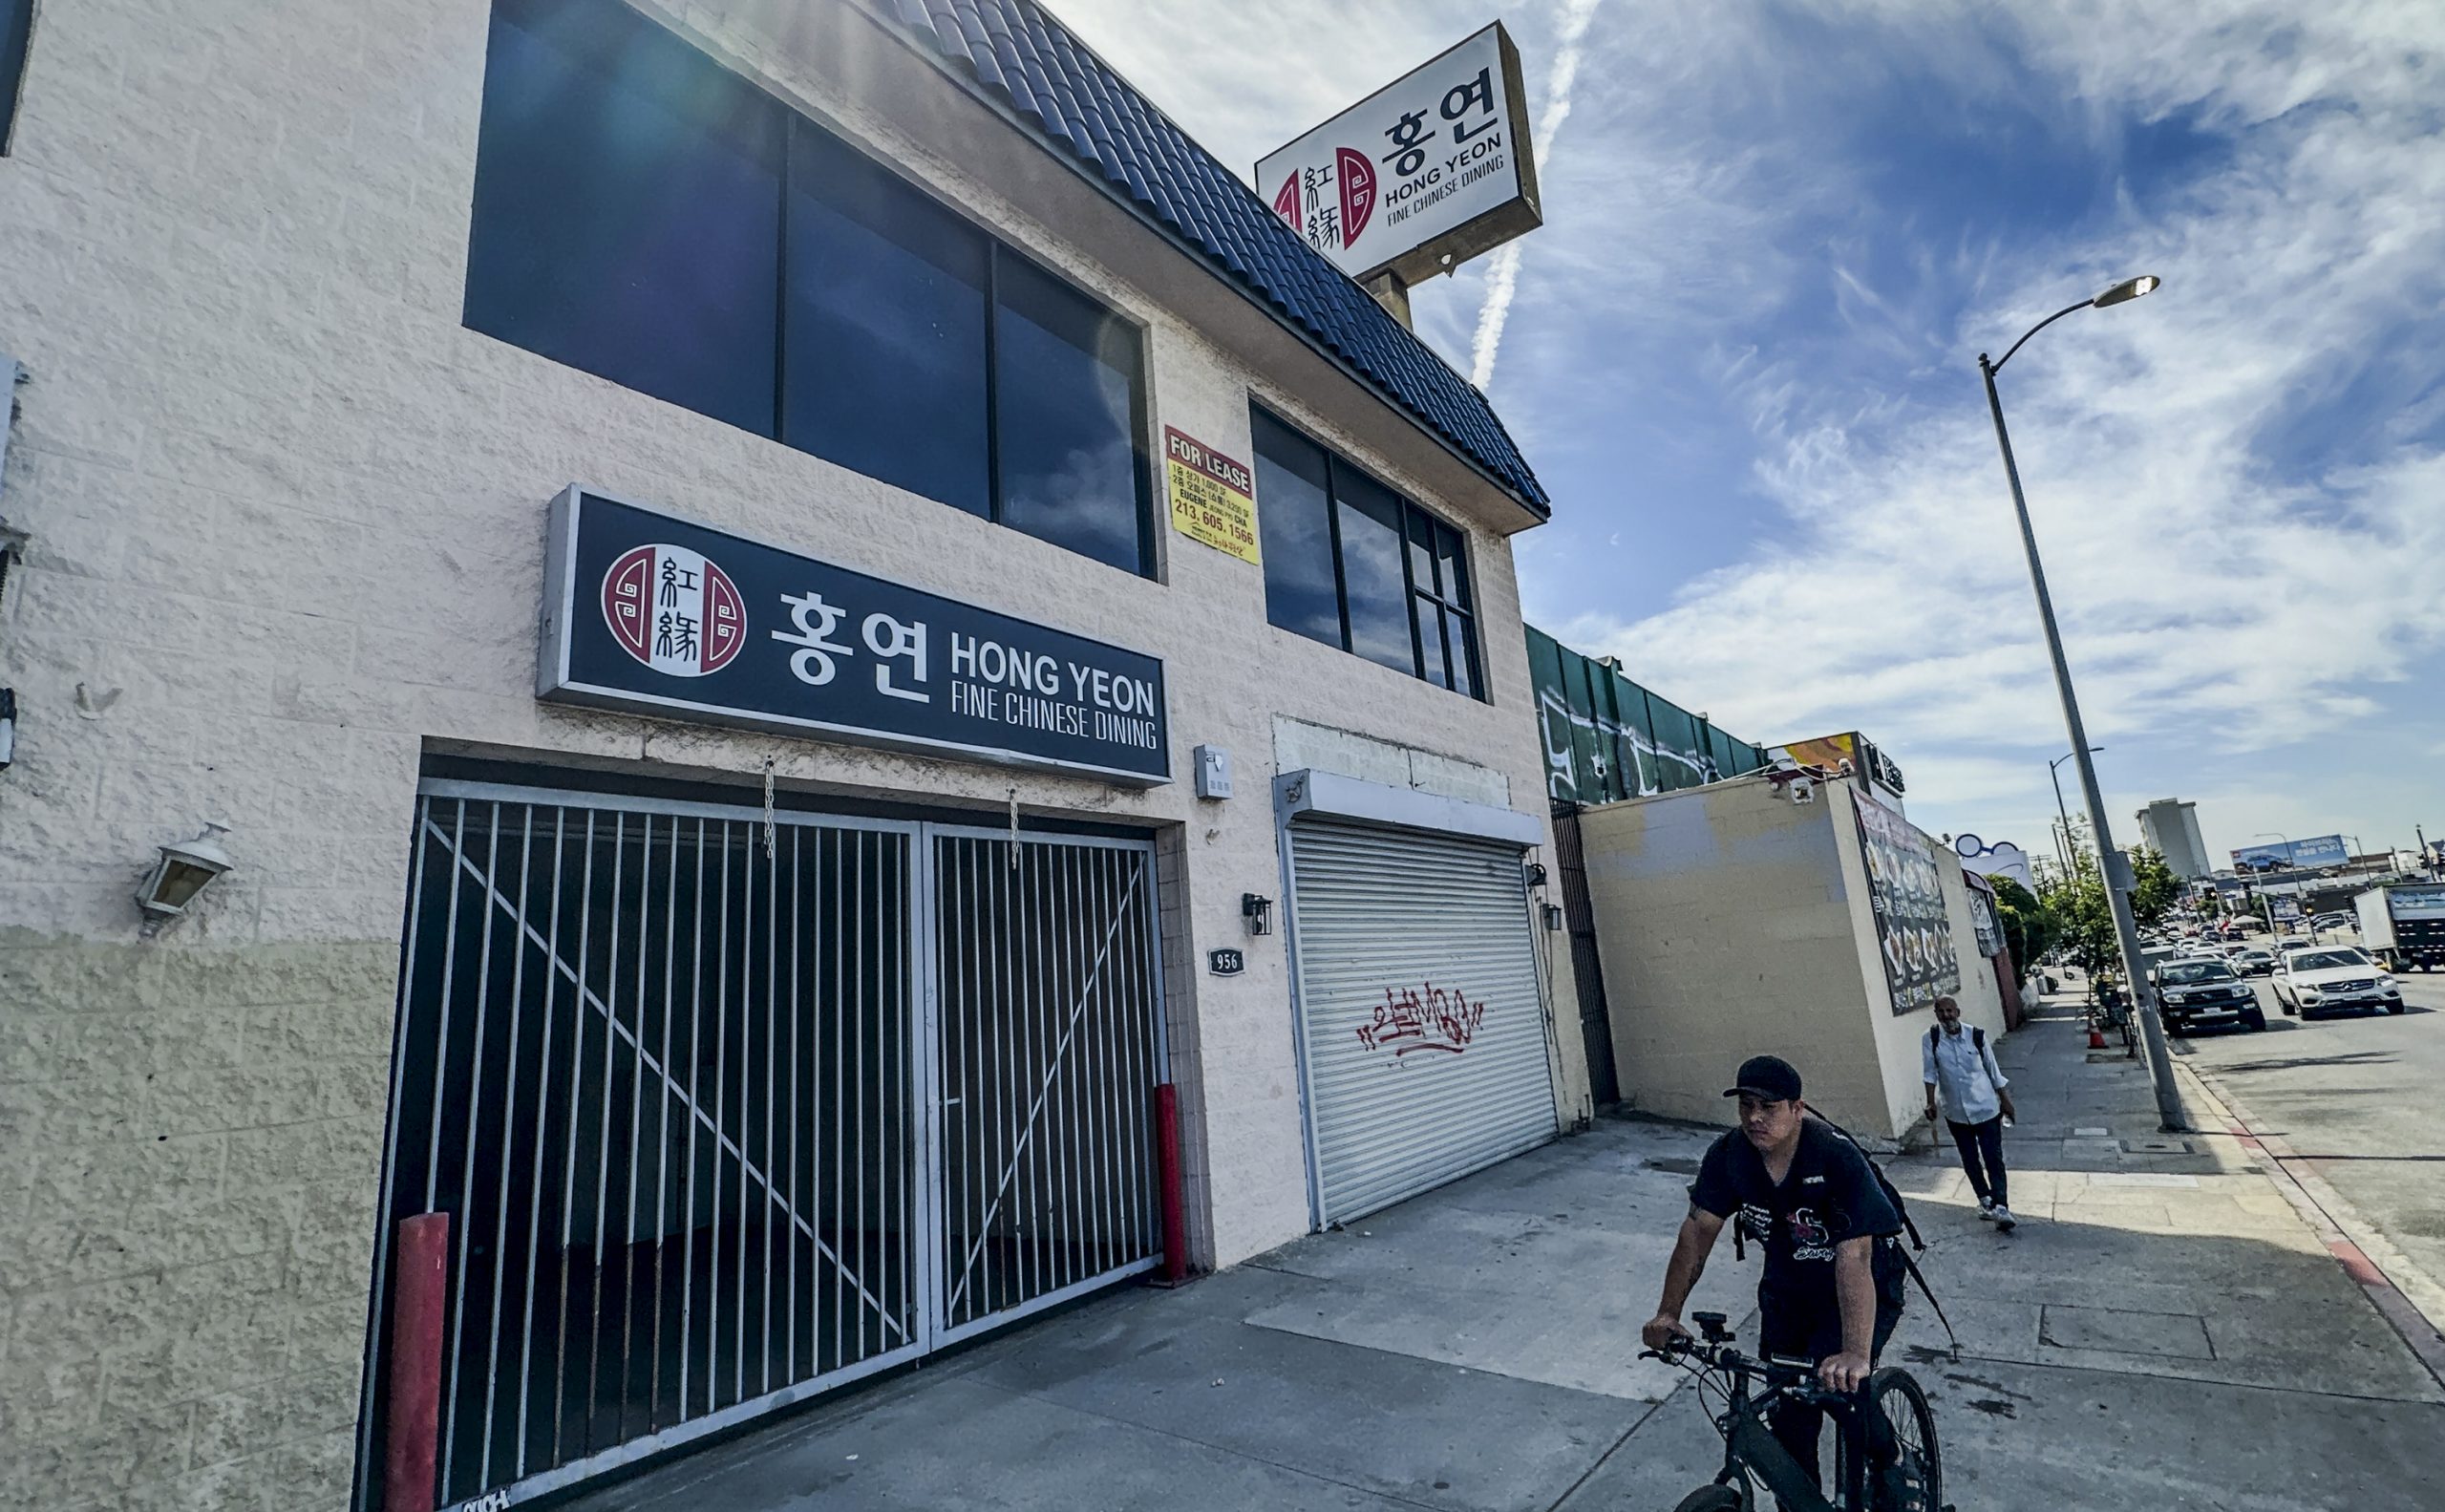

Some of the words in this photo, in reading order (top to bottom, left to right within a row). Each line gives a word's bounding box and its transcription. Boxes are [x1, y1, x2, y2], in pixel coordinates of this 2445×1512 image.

[1382, 67, 1498, 177] 홍연
[1386, 168, 1441, 207] HONG
[1445, 132, 1501, 173] YEON
[1388, 204, 1411, 227] FINE
[1414, 178, 1458, 214] CHINESE
[1461, 154, 1504, 187] DINING
[1170, 435, 1201, 467] FOR
[1205, 453, 1249, 492] LEASE
[1180, 489, 1207, 508] EUGENE
[1229, 523, 1254, 545] 1566
[772, 591, 930, 704] 홍연
[951, 631, 1060, 695] HONG
[1068, 662, 1155, 717] YEON
[952, 680, 999, 721] FINE
[1005, 692, 1090, 738] CHINESE
[1095, 711, 1157, 750] DINING
[1217, 954, 1238, 969] 956
